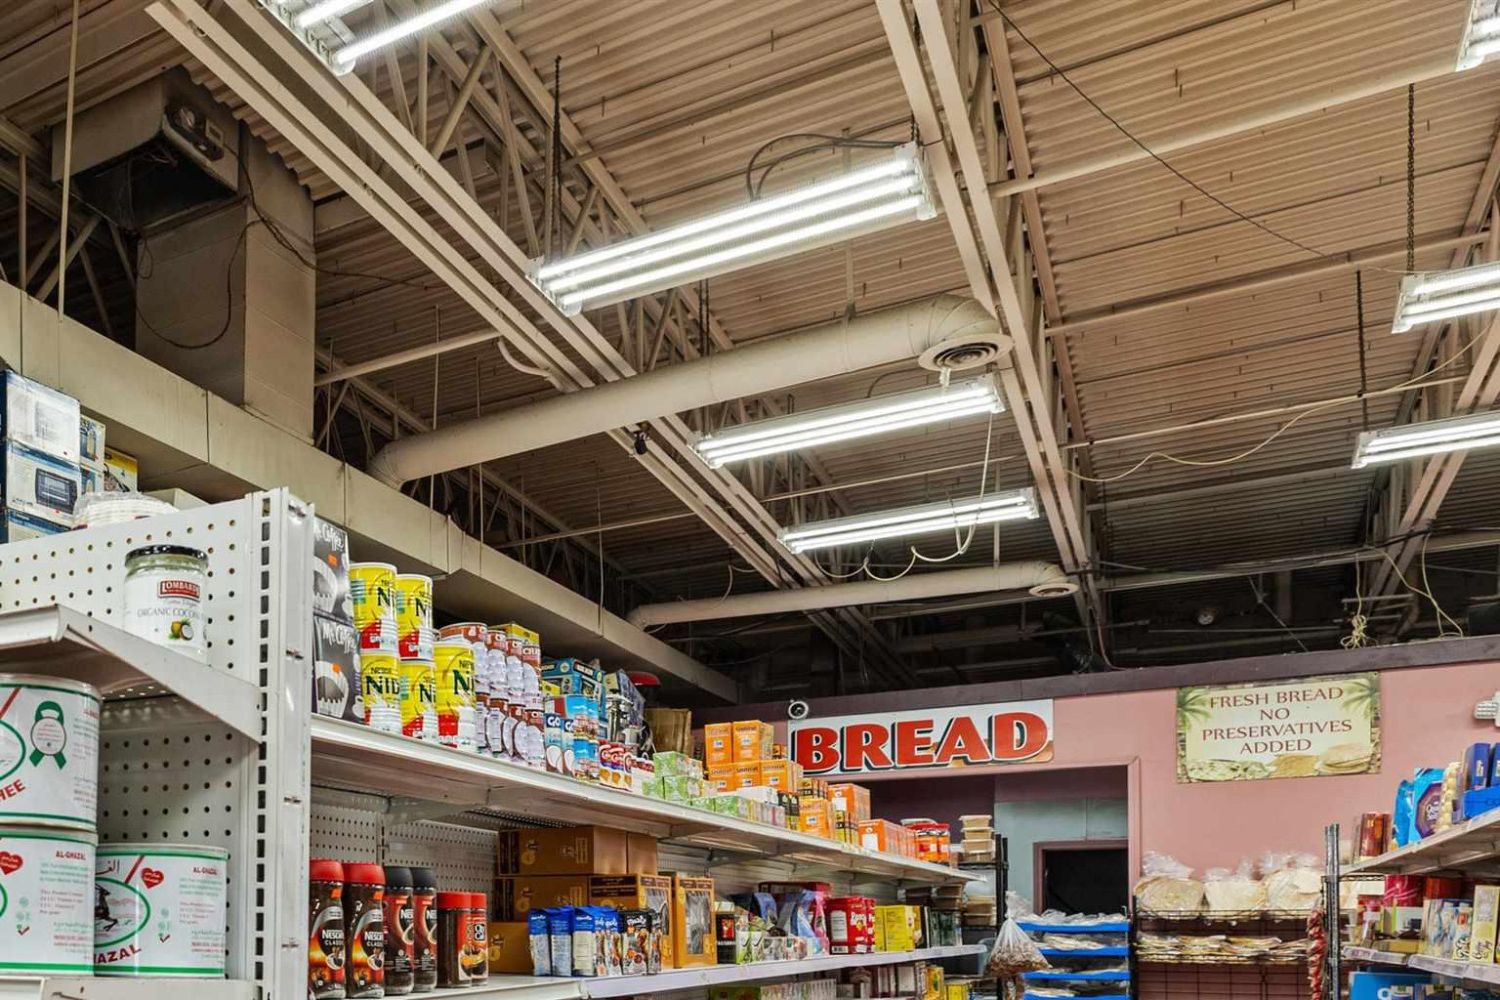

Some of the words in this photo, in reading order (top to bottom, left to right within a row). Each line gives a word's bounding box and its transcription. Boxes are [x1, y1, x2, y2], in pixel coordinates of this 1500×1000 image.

[171, 607, 202, 619] COCON
[1209, 693, 1269, 709] FRESH
[1276, 686, 1344, 704] BREAD
[1259, 707, 1290, 721] NO
[1202, 719, 1353, 741] PRESERVATIVES
[792, 711, 1049, 774] BREAD
[1239, 738, 1312, 755] ADDED
